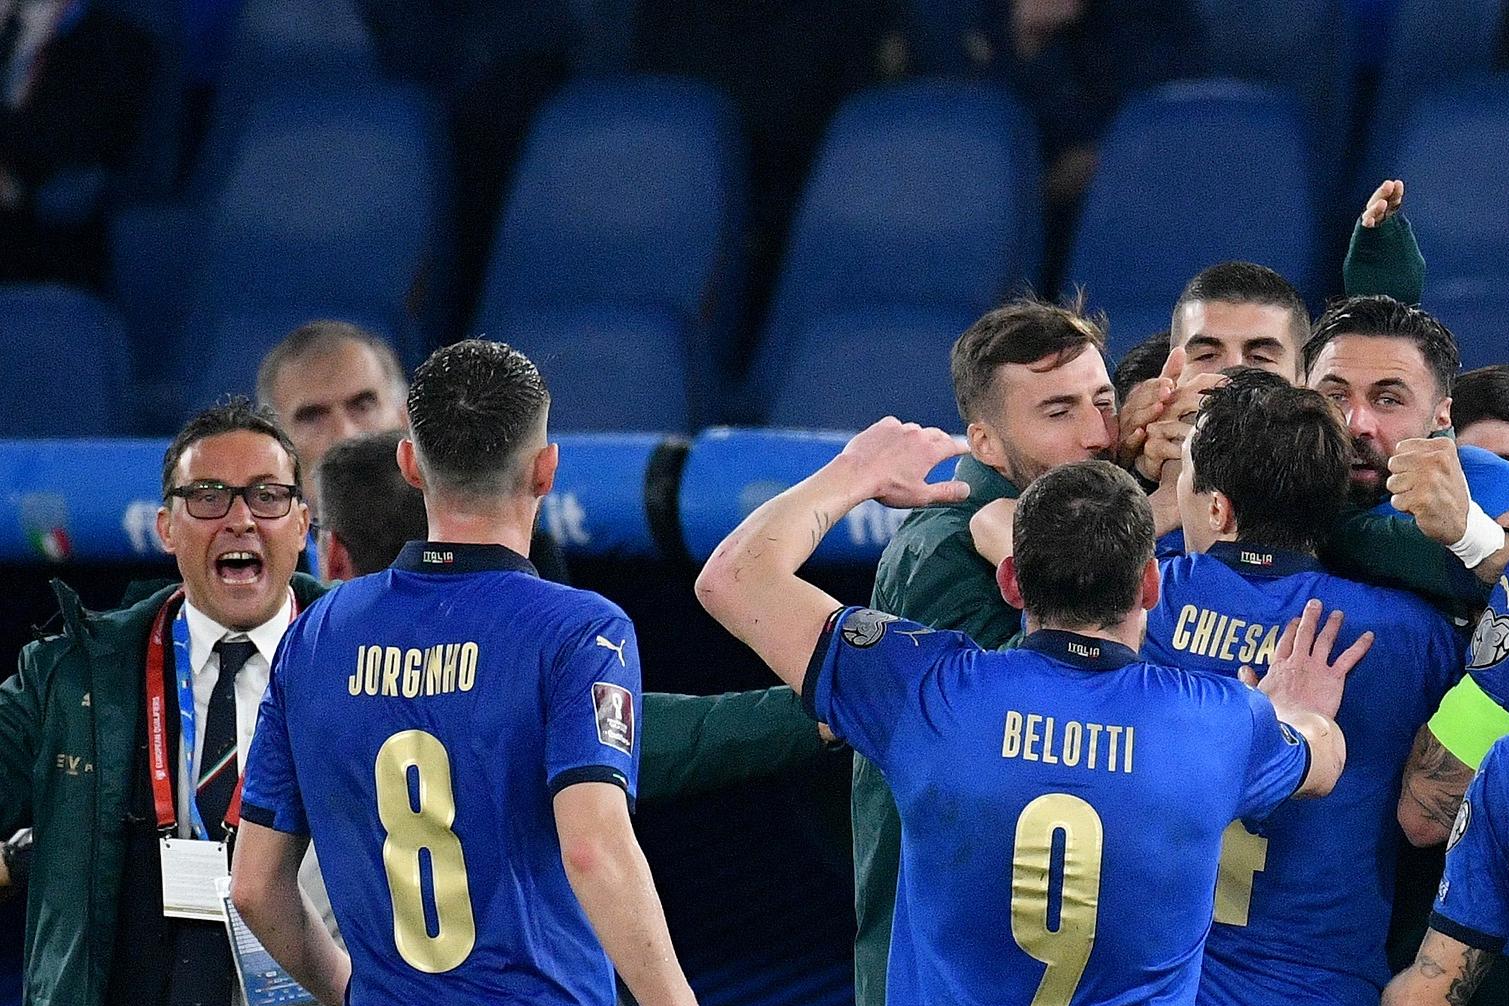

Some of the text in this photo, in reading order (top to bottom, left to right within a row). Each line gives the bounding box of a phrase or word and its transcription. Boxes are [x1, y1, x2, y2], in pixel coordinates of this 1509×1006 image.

[423, 550, 454, 564] ITALIA
[1240, 551, 1273, 565] ITALIA
[1067, 641, 1100, 658] ITALIA
[1172, 604, 1281, 665] CHIESA
[348, 641, 479, 698] JORGINHO
[1001, 710, 1135, 774] BELOTTI
[374, 729, 476, 973] 8
